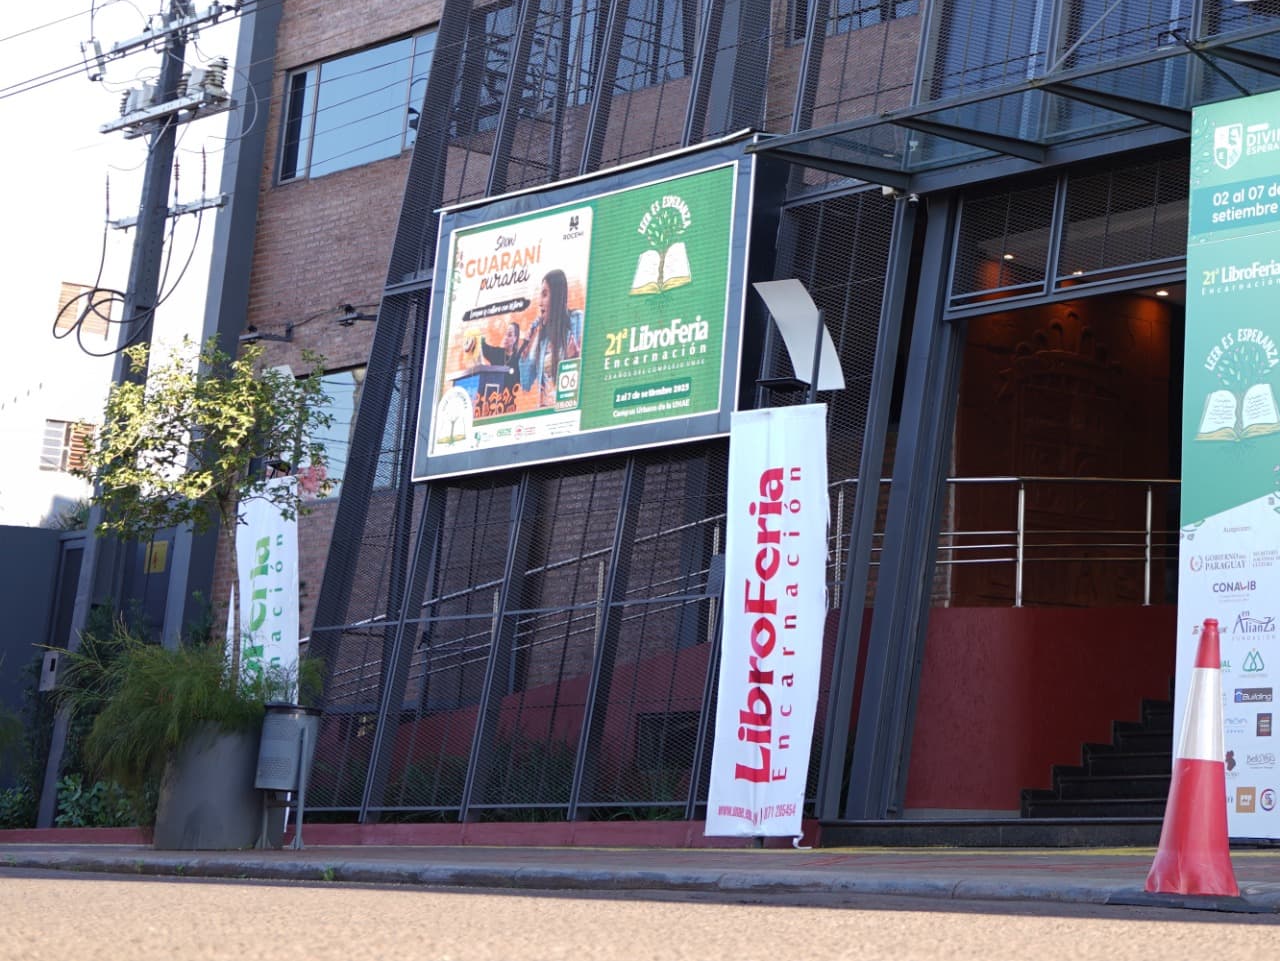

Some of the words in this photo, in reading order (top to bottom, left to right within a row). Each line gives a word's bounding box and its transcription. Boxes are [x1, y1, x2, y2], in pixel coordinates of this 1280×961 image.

[1212, 191, 1229, 207] 02
[1232, 188, 1245, 204] al
[1247, 185, 1266, 202] 07
[1211, 201, 1279, 224] setiembre
[465, 238, 542, 278] GUARANÍ
[604, 328, 628, 357] 21ª
[629, 315, 709, 353] LibroFeria
[1204, 345, 1223, 372] LEER
[1220, 332, 1235, 350] ES
[1237, 328, 1280, 368] ESPERANZA
[604, 342, 707, 370] Encarnación
[560, 375, 576, 389] 06
[1204, 552, 1239, 562] GOBIERNO
[1205, 559, 1247, 571] PARAGUAY
[1212, 580, 1257, 593] CONALIB
[270, 533, 284, 669] nación
[735, 466, 785, 784] LibroFeria
[771, 466, 802, 782] Encarnación
